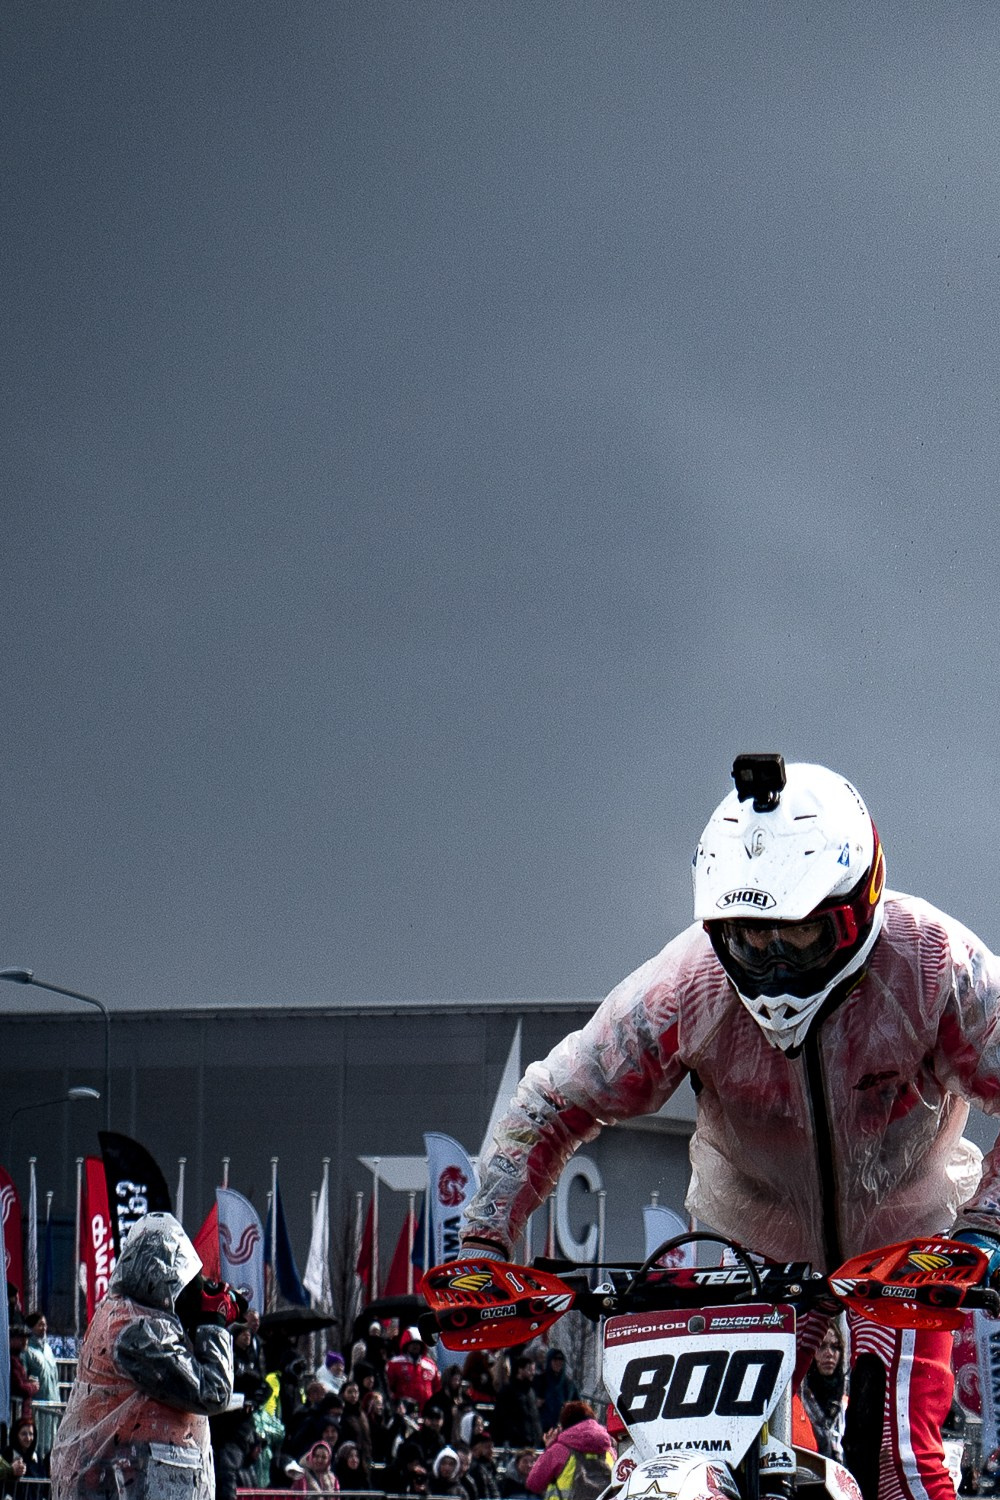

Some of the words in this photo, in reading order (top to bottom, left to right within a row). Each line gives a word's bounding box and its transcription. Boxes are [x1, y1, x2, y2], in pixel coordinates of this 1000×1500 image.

[723, 890, 769, 907] SHOEI
[882, 1285, 917, 1299] CYCRA
[480, 1304, 517, 1320] CYCRA
[606, 1322, 687, 1340] БИРЮКОВ
[617, 1350, 784, 1426] 800
[656, 1439, 732, 1454] TAKAYAMA
